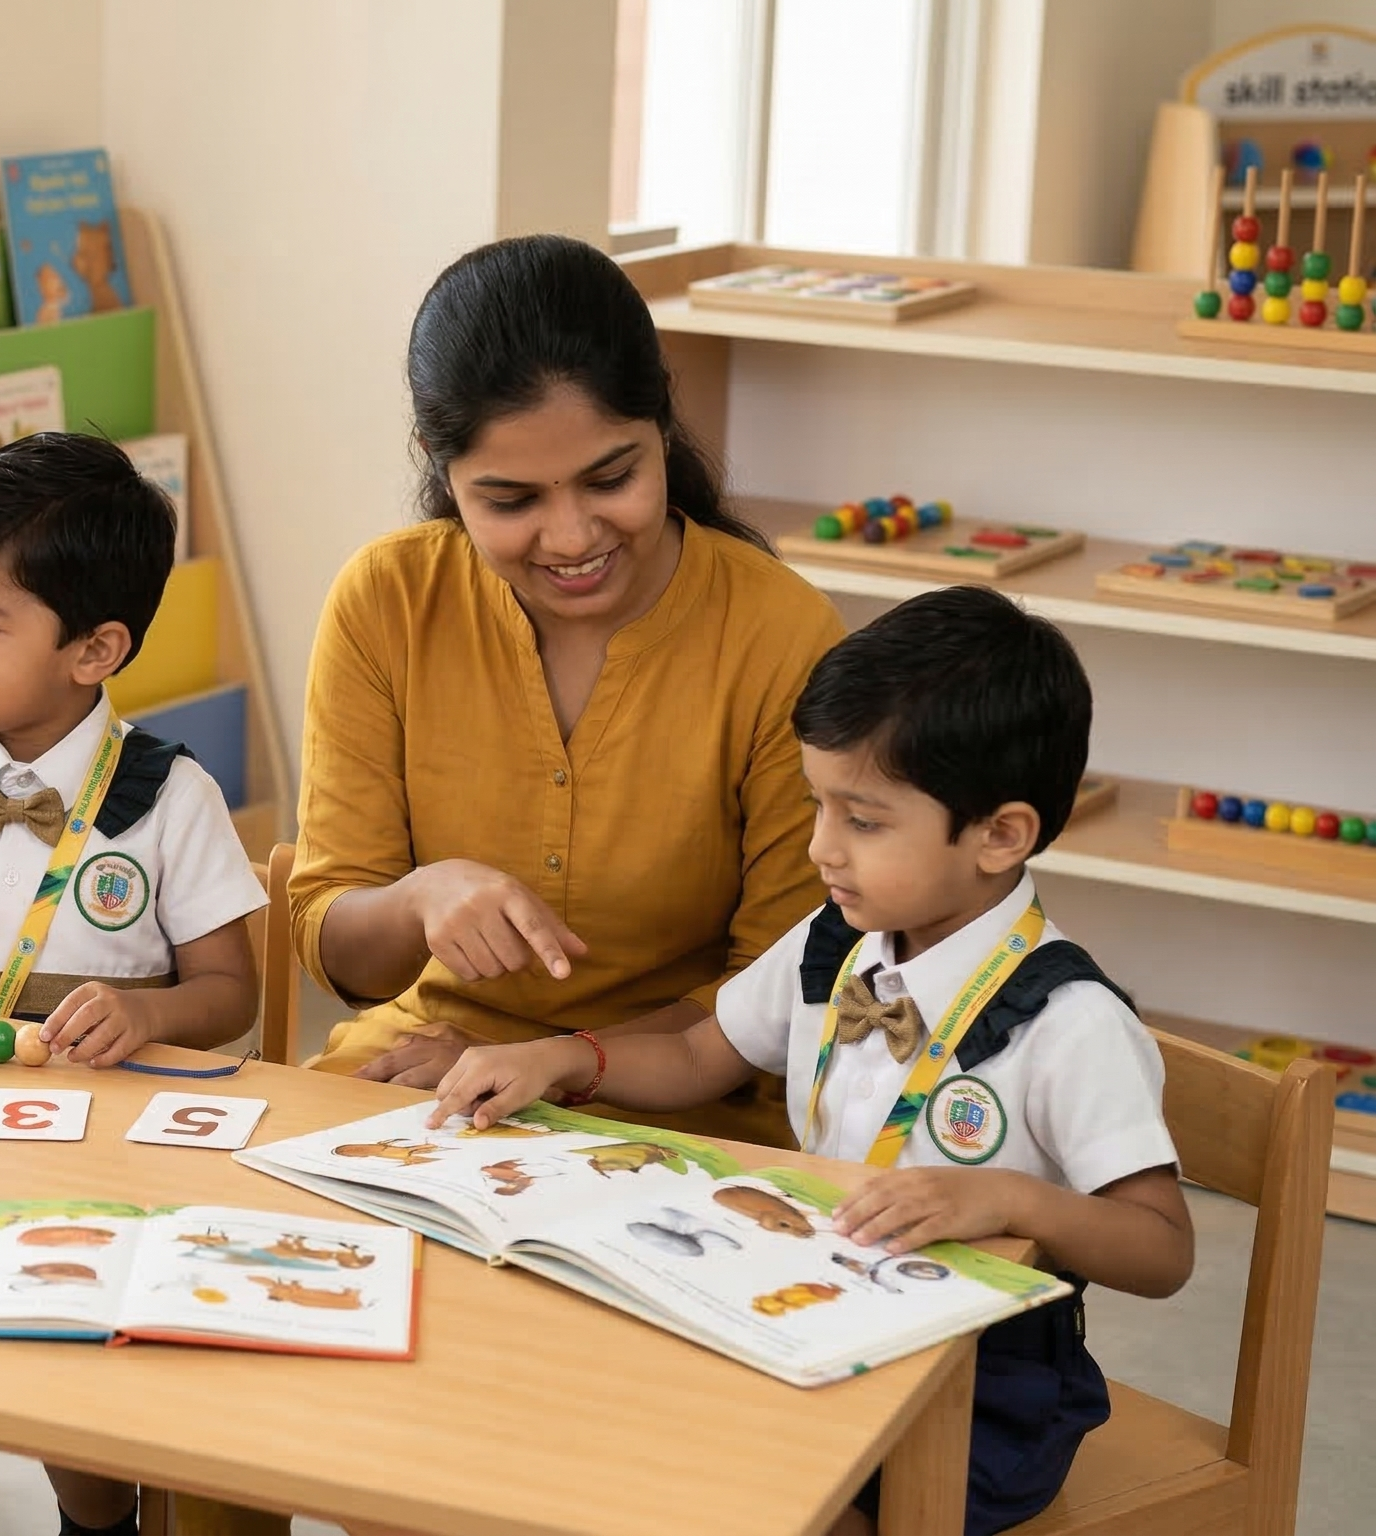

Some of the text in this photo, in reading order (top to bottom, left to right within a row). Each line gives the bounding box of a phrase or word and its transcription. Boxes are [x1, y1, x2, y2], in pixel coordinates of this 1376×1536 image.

[1225, 73, 1285, 107] skill
[2, 1100, 60, 1129] 3
[161, 1106, 228, 1136] 5
